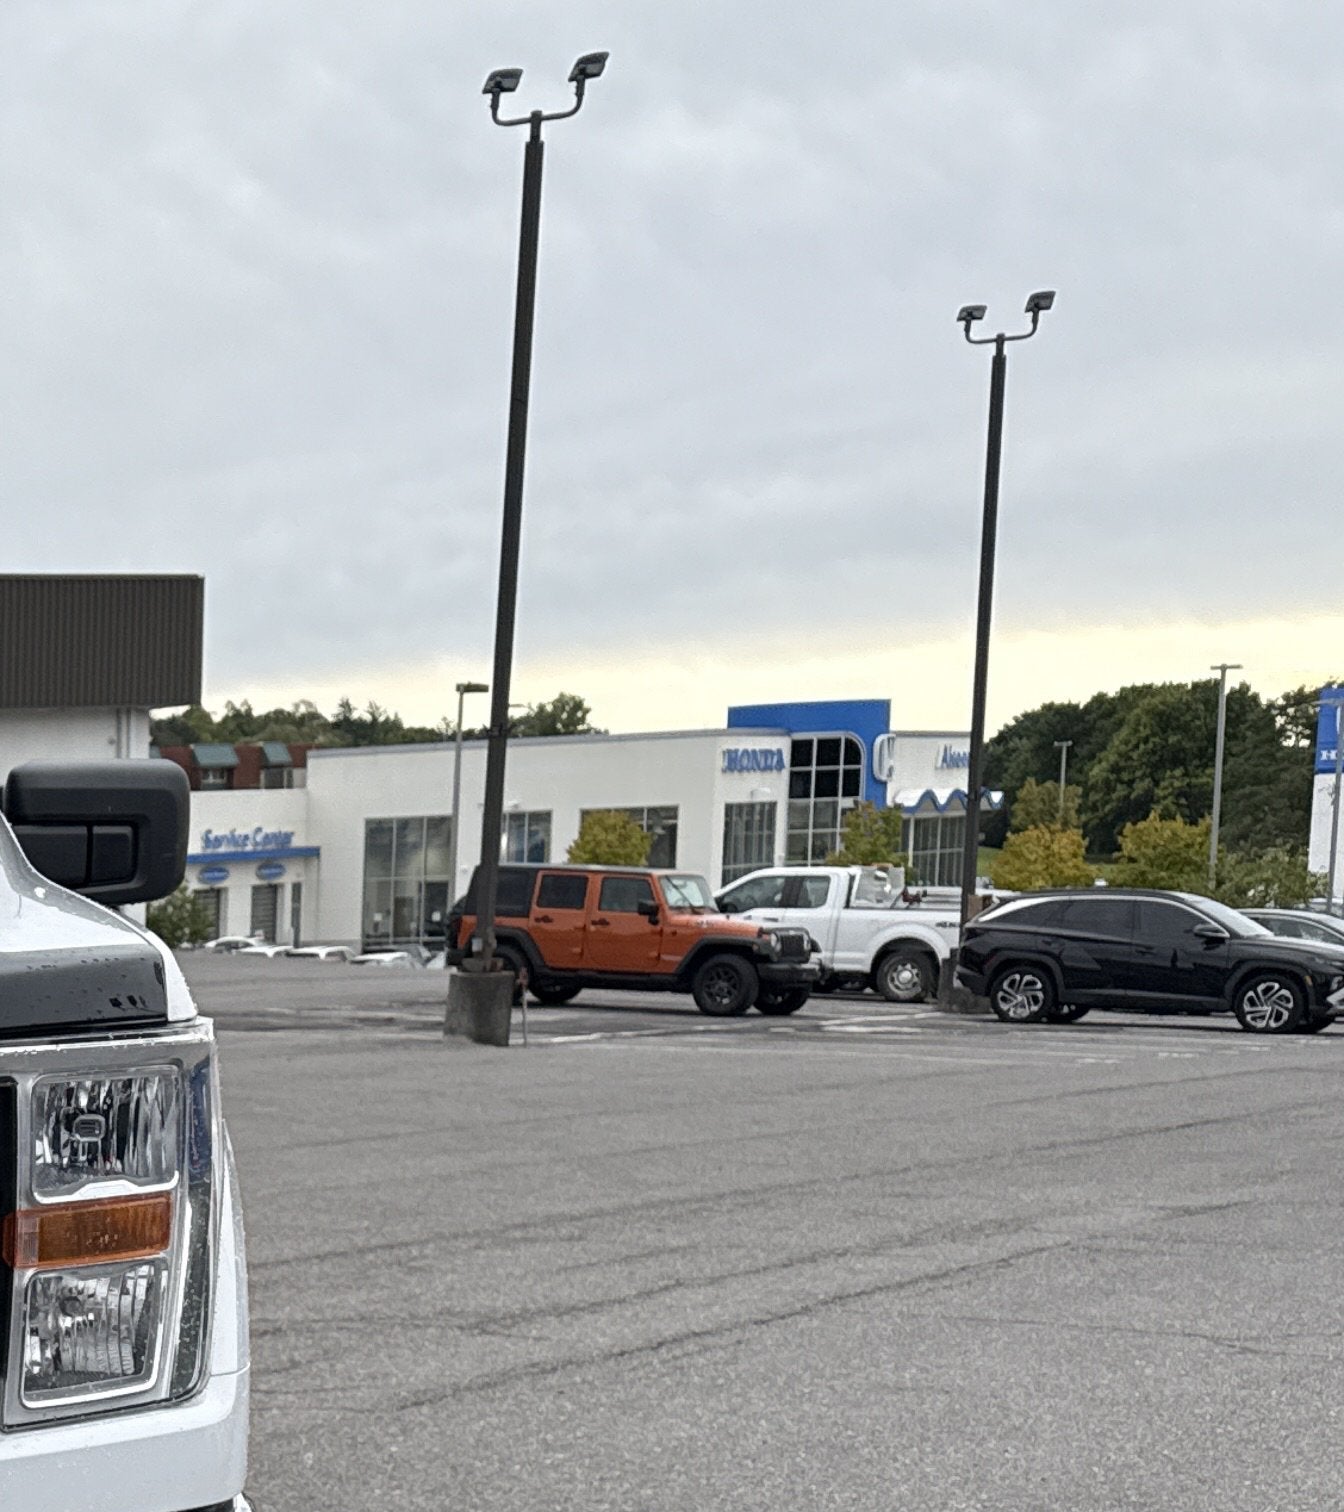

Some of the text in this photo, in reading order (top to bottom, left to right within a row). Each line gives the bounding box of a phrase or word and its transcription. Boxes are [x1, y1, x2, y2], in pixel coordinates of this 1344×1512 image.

[722, 748, 785, 773] HONDA
[202, 826, 294, 849] Service Center
